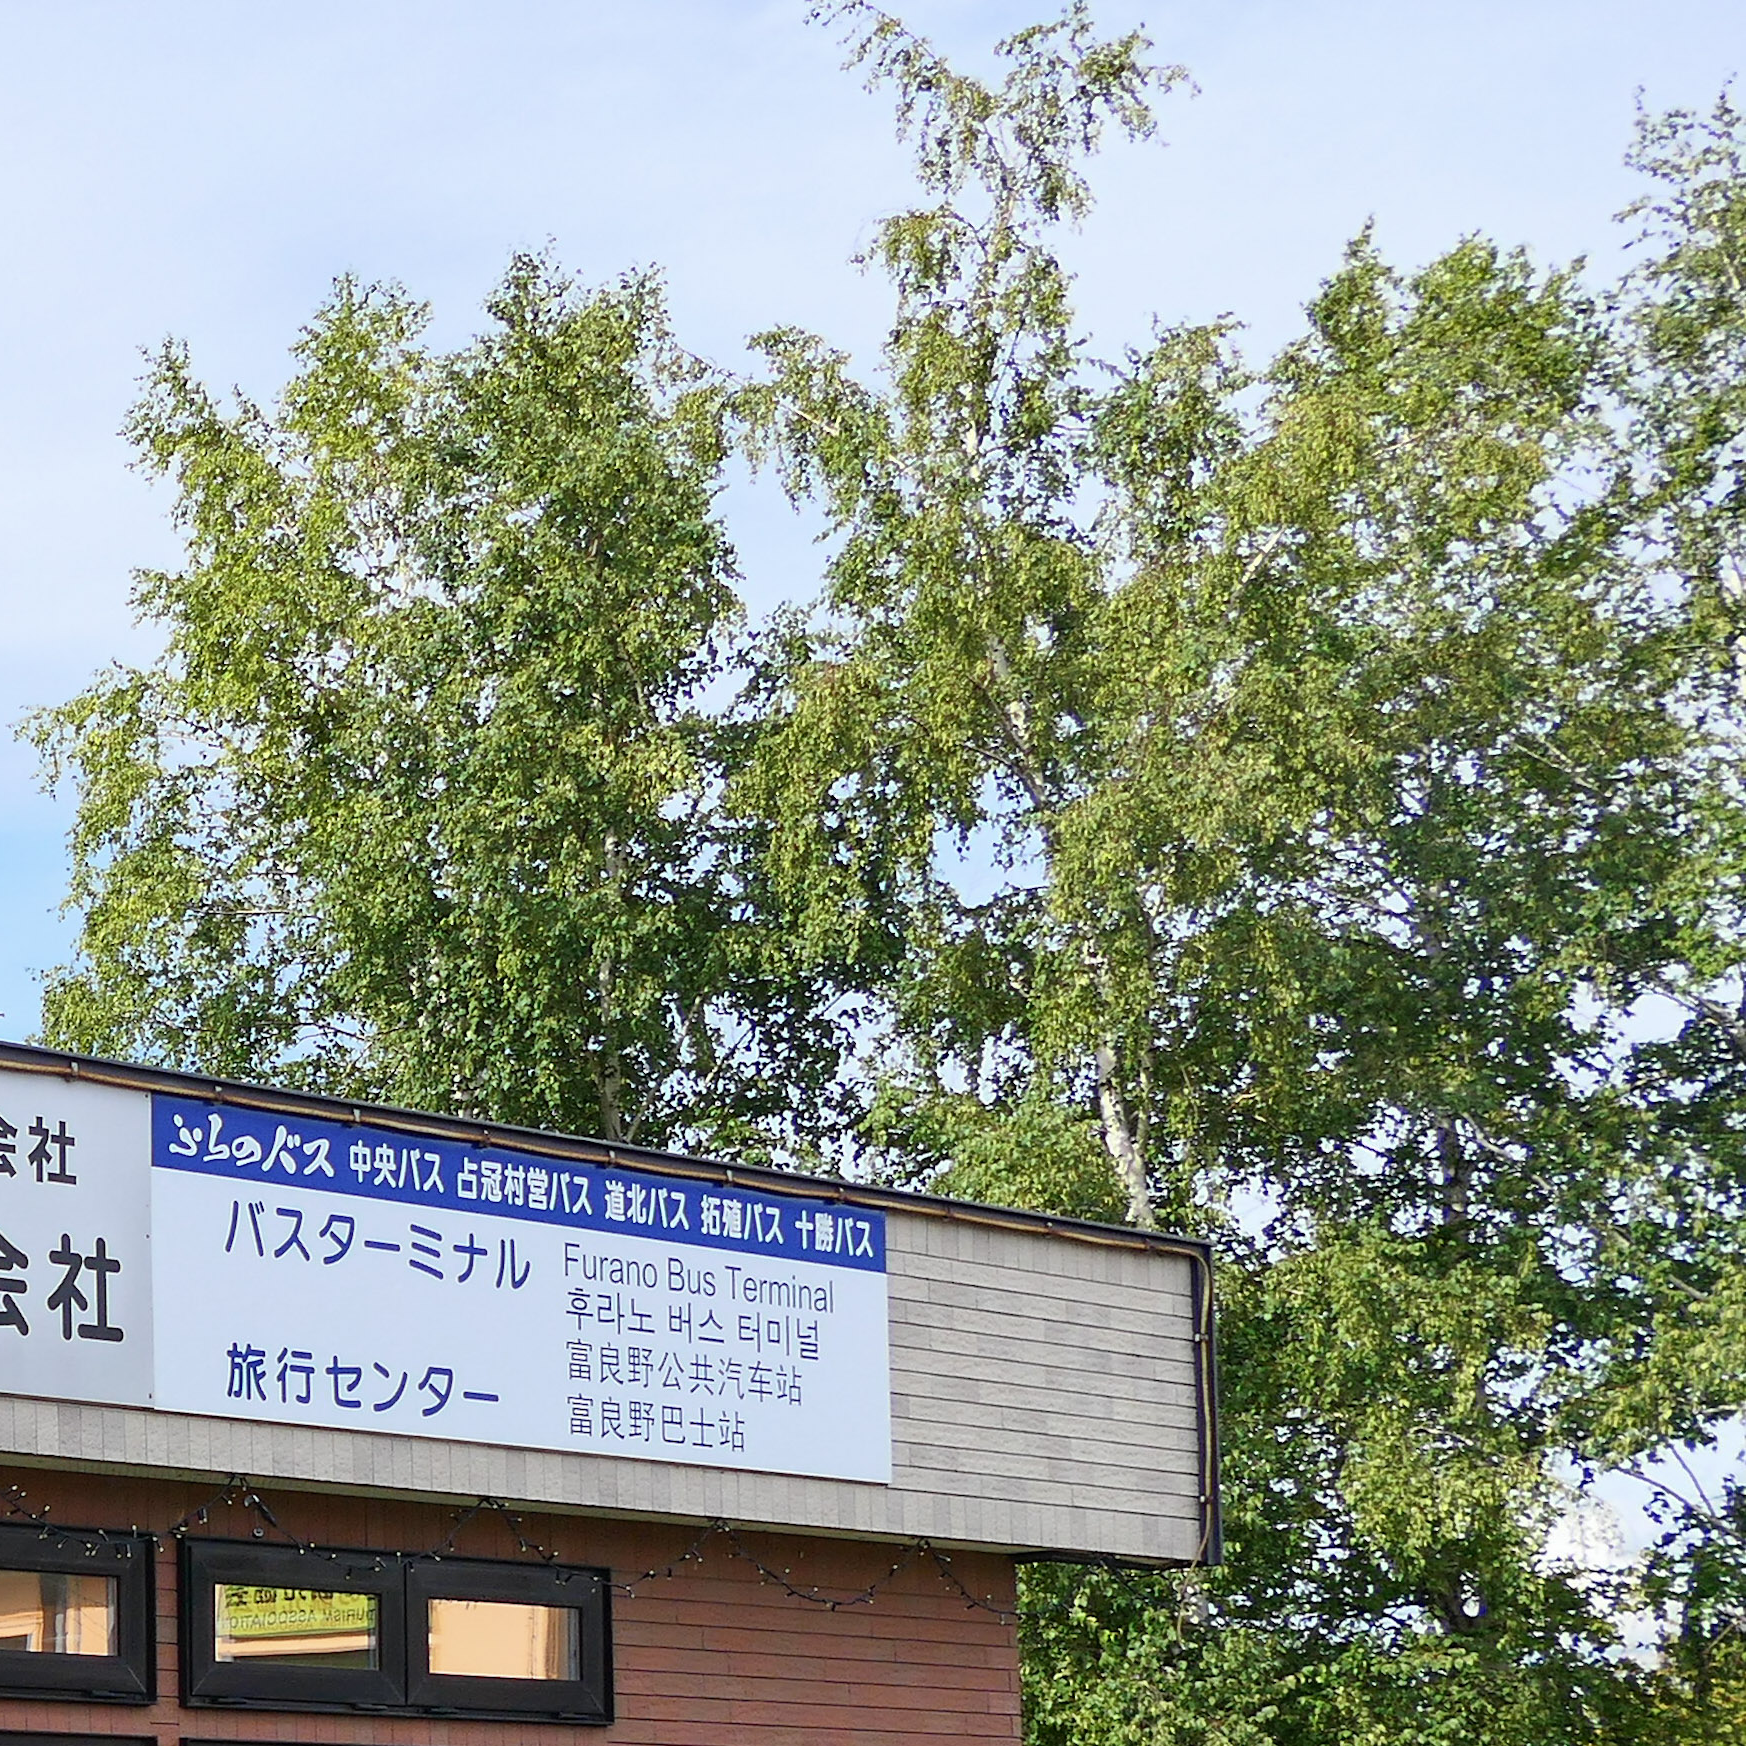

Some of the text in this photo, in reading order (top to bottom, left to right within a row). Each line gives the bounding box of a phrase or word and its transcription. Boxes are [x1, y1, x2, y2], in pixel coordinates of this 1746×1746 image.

[348, 1143, 445, 1195] 中央バス
[457, 1161, 593, 1217] 占冠村営バス
[604, 1180, 691, 1232] 道北バス
[700, 1193, 784, 1247] 拓殖バス
[794, 1209, 876, 1260] 十勝バス
[225, 1200, 532, 1292] バスターミナル
[563, 1242, 834, 1314] Furano Bus Terminal
[565, 1288, 821, 1362] 후라노 버스 터미널
[225, 1342, 500, 1419] 旅行センター
[565, 1340, 803, 1407] 富良野公共汽车站
[566, 1394, 745, 1454] 富良野巴士站
